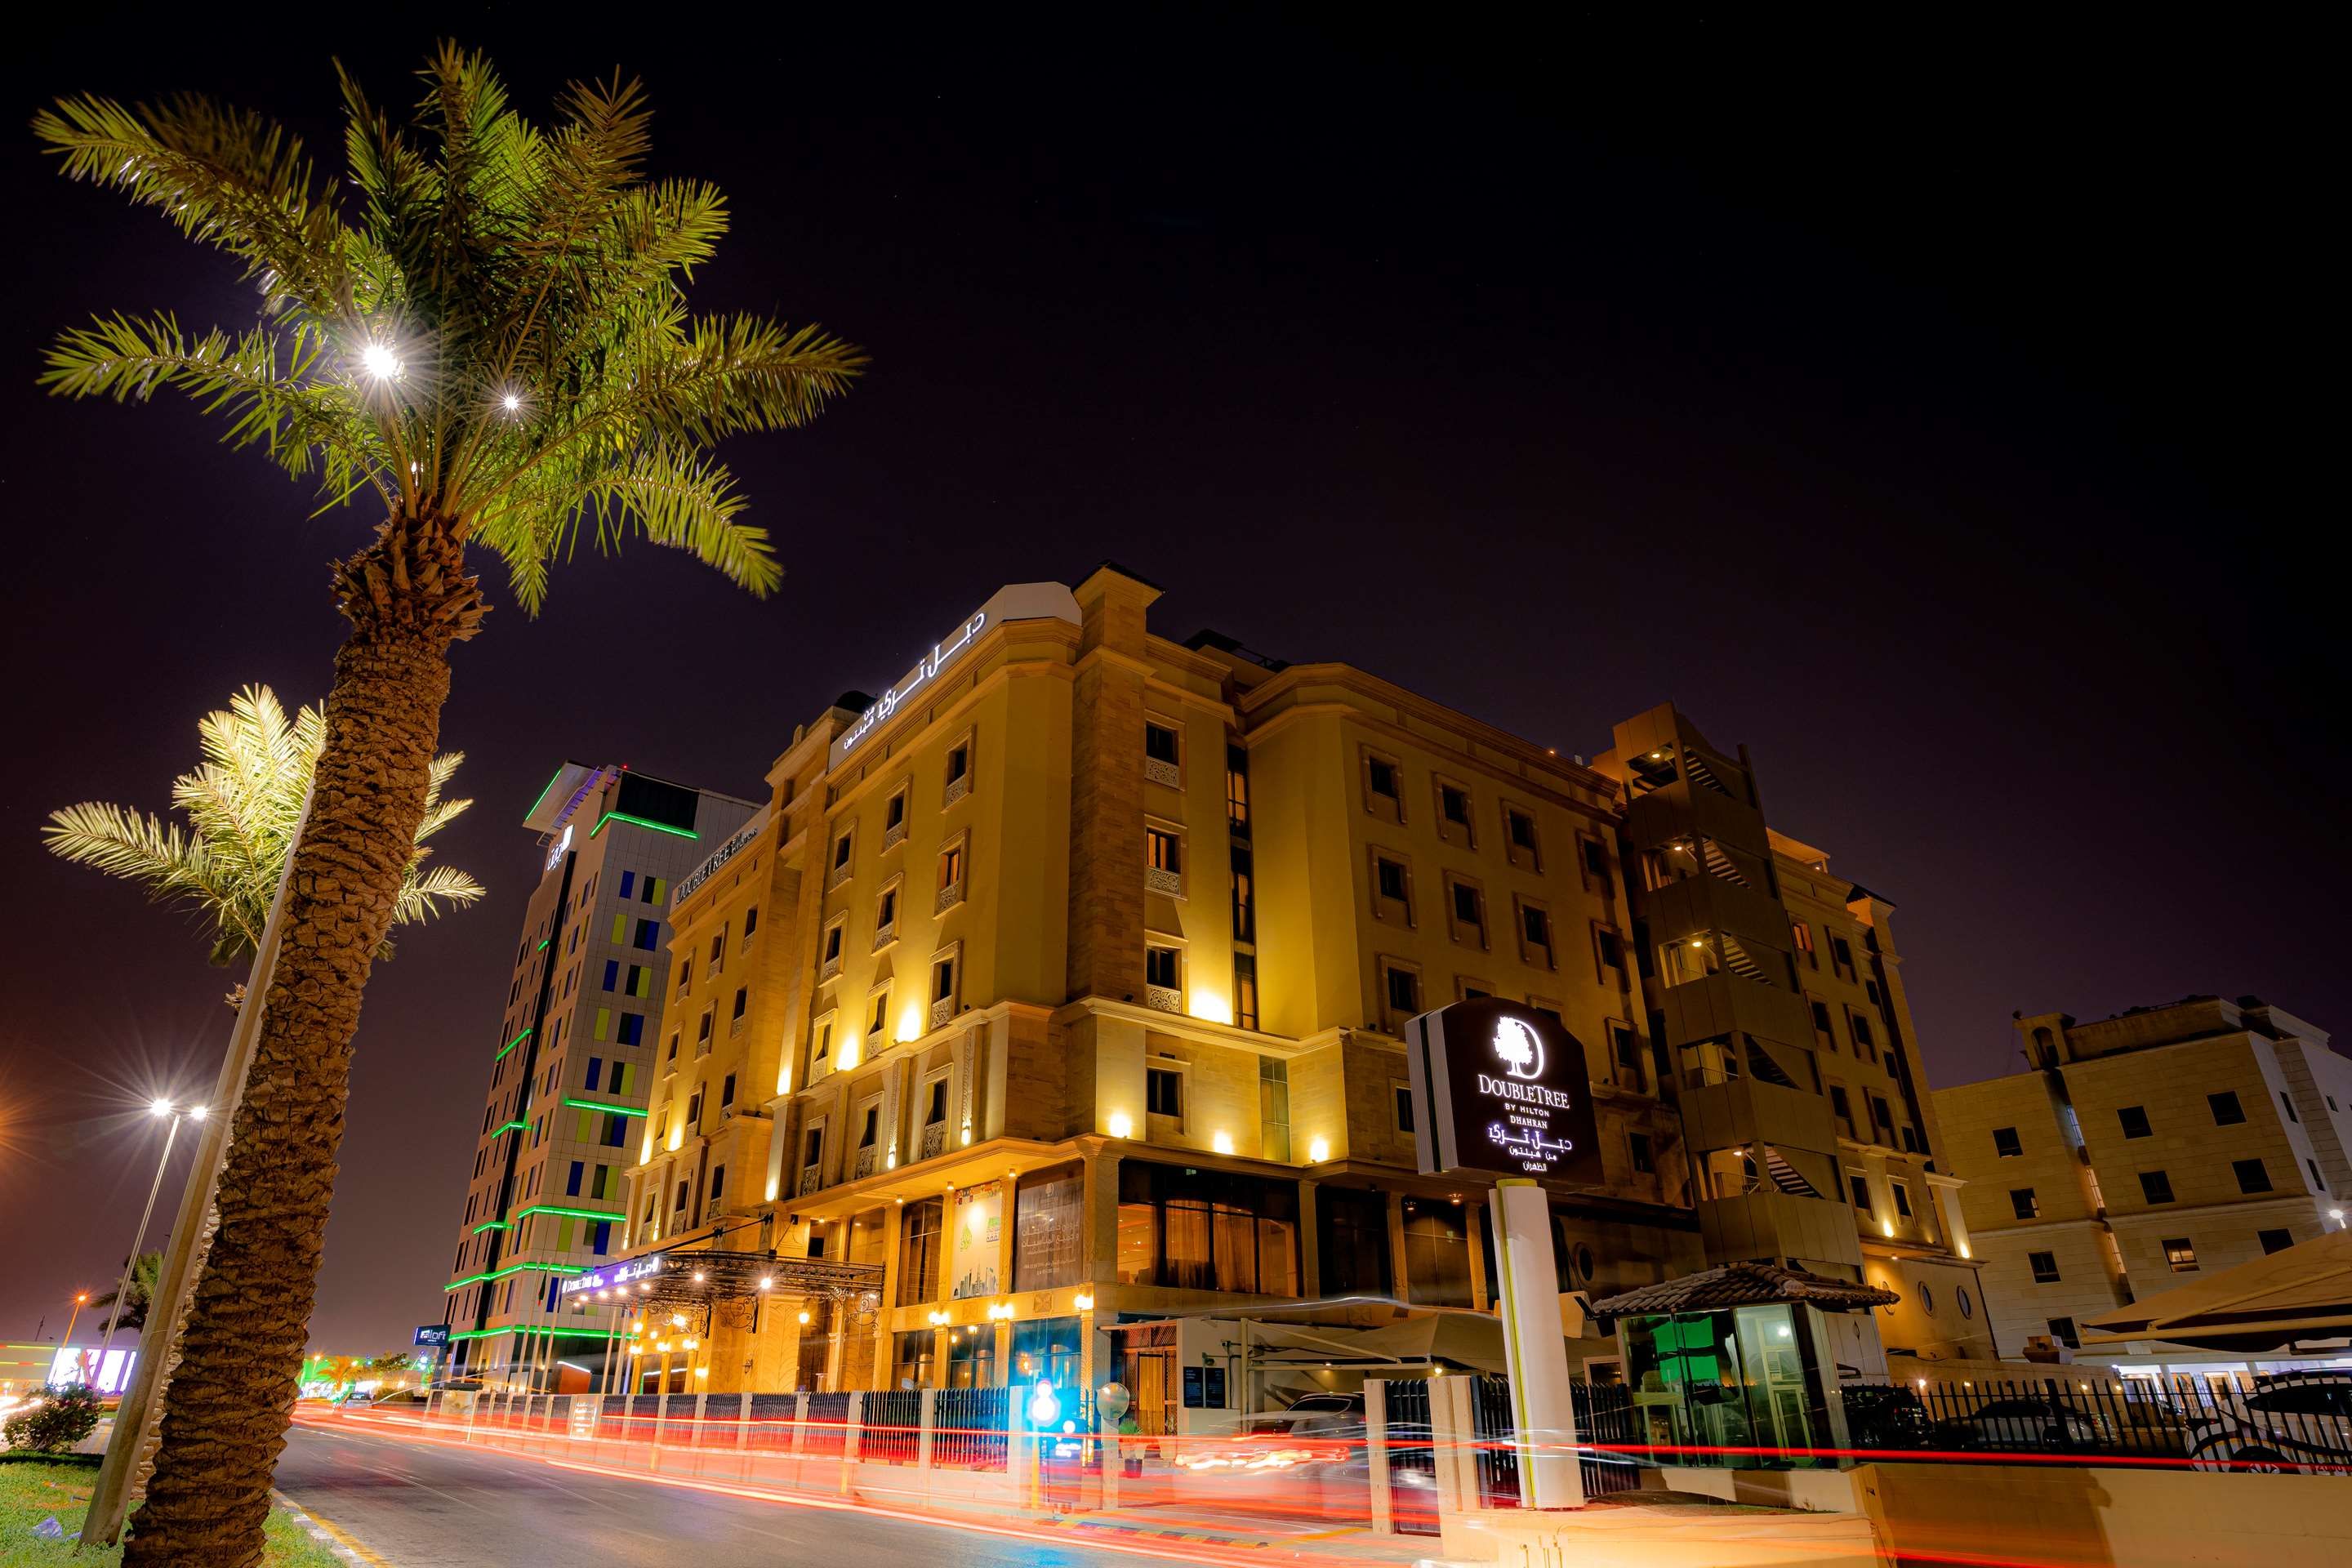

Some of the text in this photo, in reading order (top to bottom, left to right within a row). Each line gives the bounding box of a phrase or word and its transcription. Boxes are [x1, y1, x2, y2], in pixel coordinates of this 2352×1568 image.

[844, 715, 875, 750] هيلتون
[1505, 1102, 1550, 1118] BY HILTON
[1510, 1116, 1548, 1129] DHAHRAN
[1509, 1145, 1557, 1161] من هيلتون
[1522, 1160, 1548, 1172] الظهران
